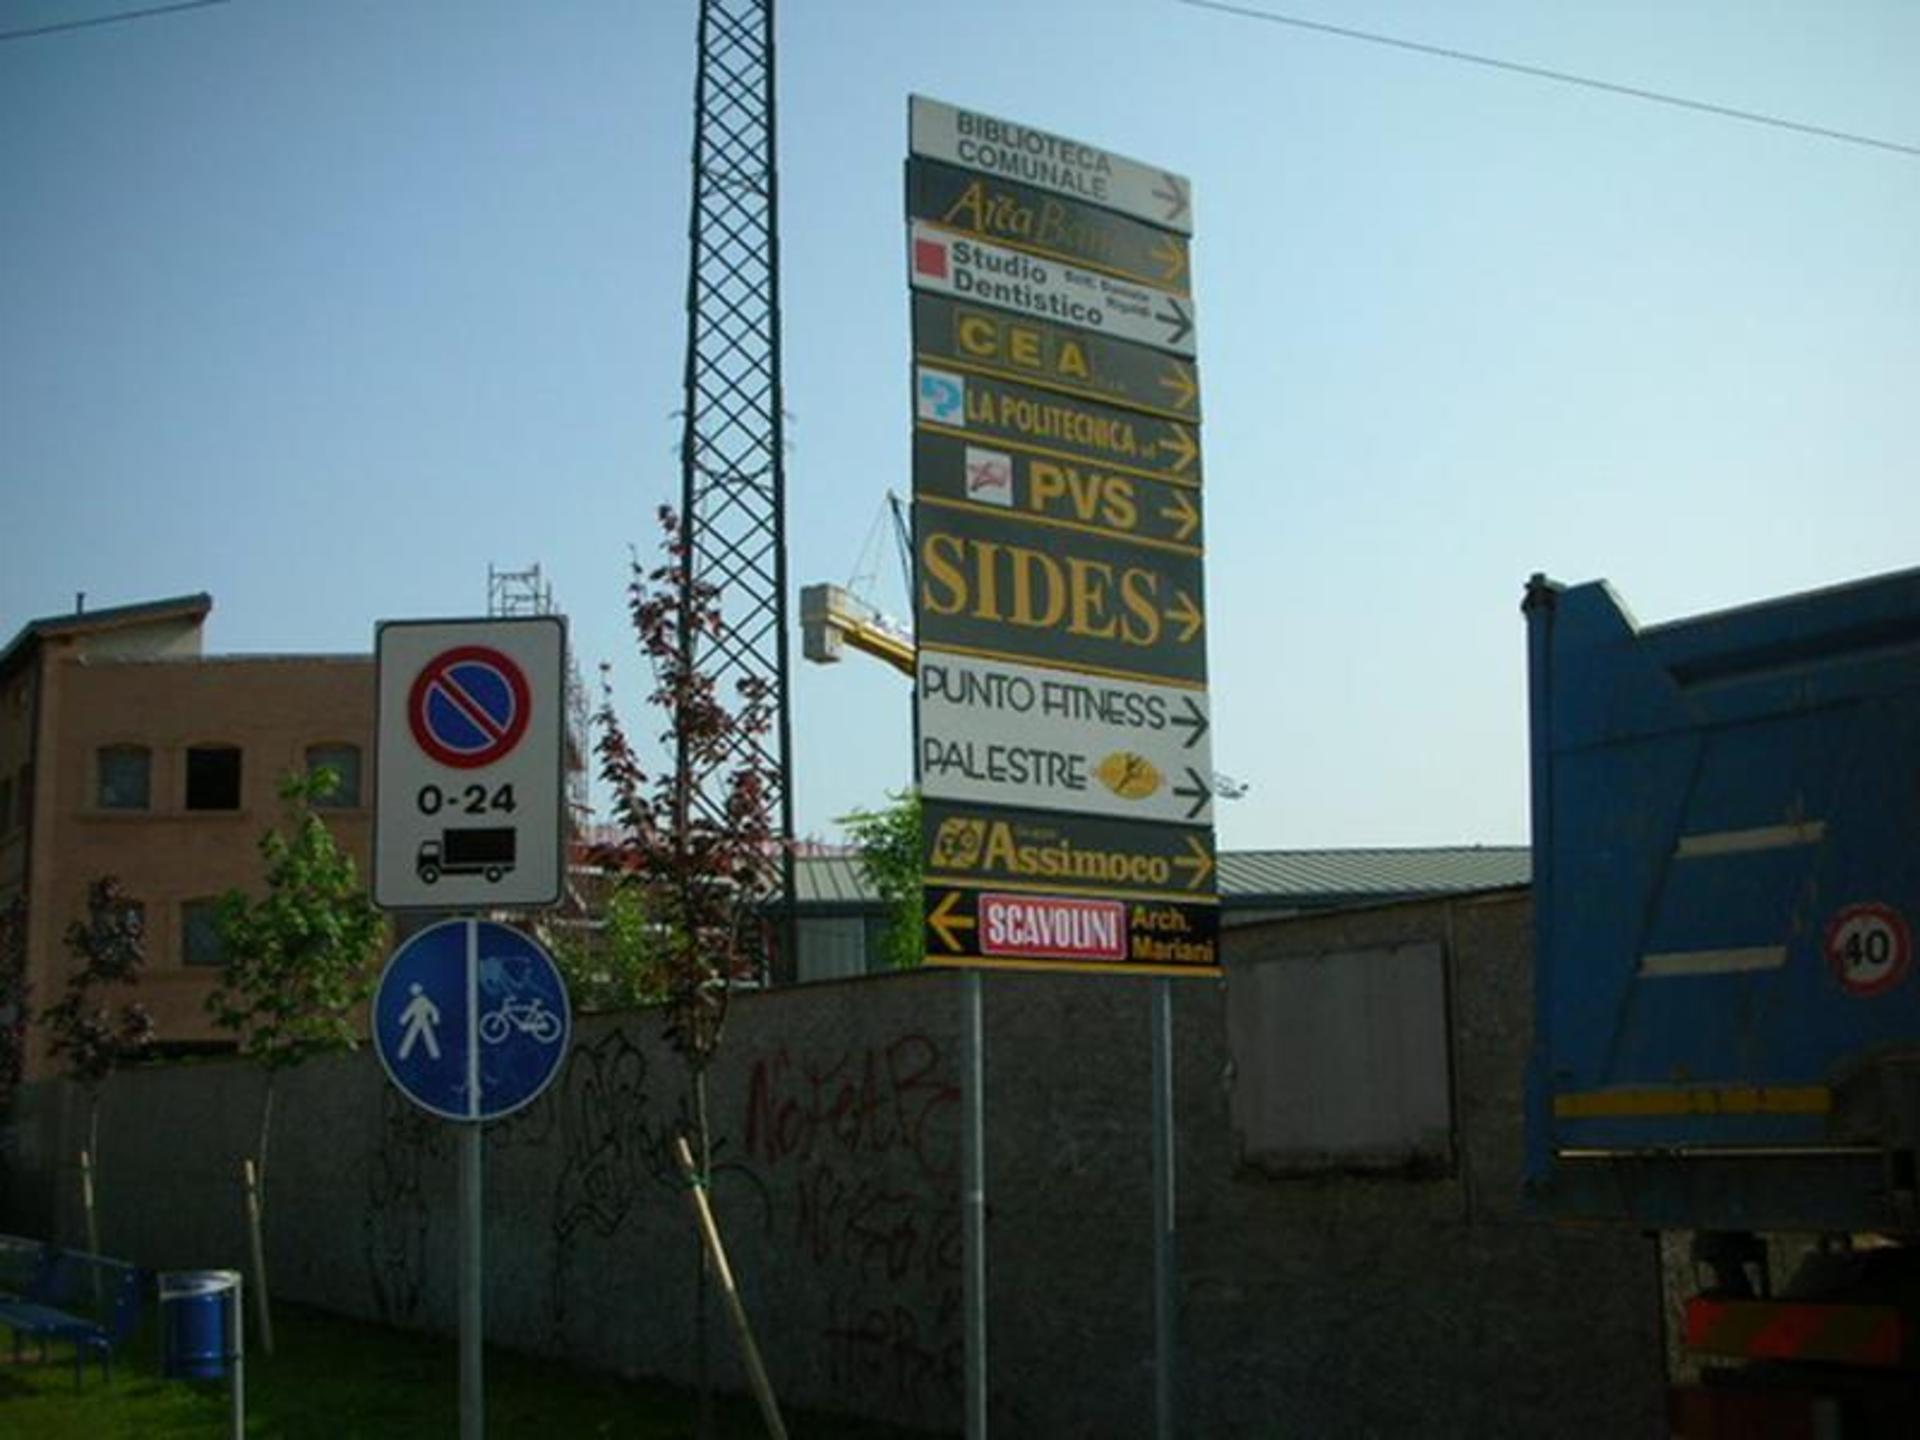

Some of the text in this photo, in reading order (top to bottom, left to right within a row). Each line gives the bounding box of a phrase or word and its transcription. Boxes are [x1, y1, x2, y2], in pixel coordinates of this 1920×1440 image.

[957, 111, 1112, 175] BIBLIOTECA
[957, 139, 1109, 200] COMUNALE
[952, 241, 1047, 283] Studio
[953, 268, 1103, 325] Dentistico
[966, 388, 1136, 455] LA POLITECNICA
[1029, 461, 1138, 529] PVS
[922, 532, 1161, 646] SIDES
[922, 664, 1166, 730] PUNTO FITNESS
[923, 737, 1087, 790] PALESTRE
[417, 784, 517, 815] 0-24
[982, 821, 1170, 883] Assimoco
[987, 904, 1118, 949] SCAVOLINI
[1132, 906, 1192, 932] Arch.
[1132, 938, 1215, 963] Mariani
[1846, 929, 1889, 967] 40
